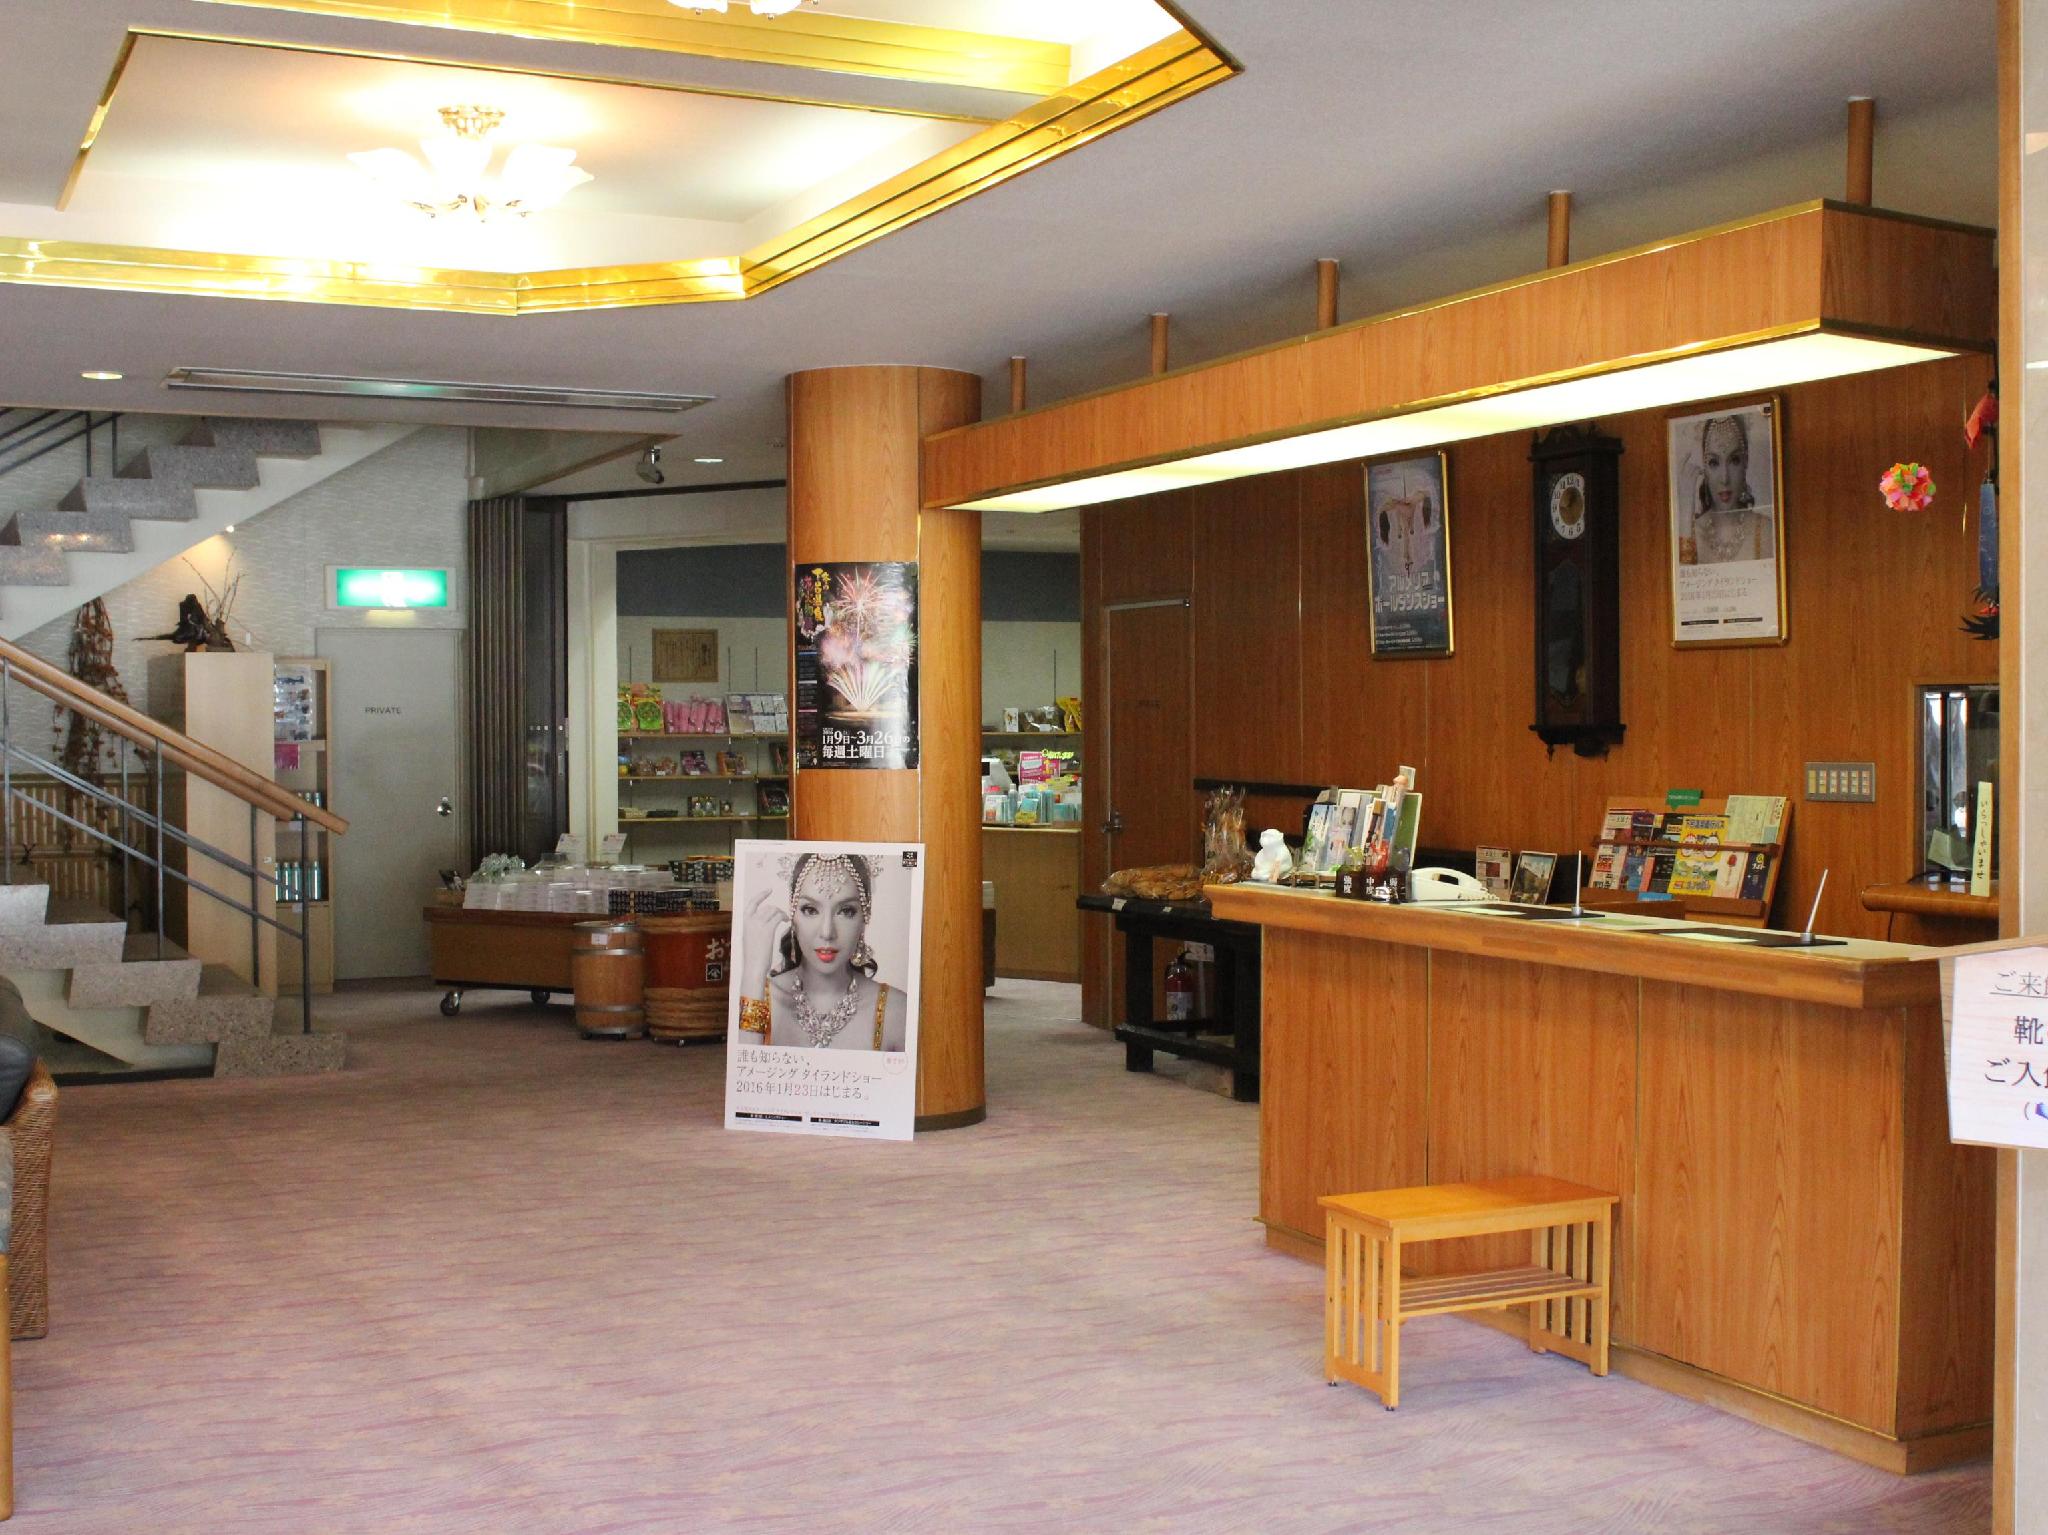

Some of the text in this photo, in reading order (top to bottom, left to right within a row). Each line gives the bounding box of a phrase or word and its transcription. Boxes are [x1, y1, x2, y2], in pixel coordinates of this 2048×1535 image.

[365, 706, 401, 714] PRIVATE
[822, 745, 885, 759] 毎週土曜日
[736, 1048, 811, 1067] 誰も知らない、
[735, 1065, 883, 1085] アメージング タイランドショー
[1984, 1057, 2048, 1089] ご入
[735, 1081, 870, 1101] 2016年1月23日はじまる。
